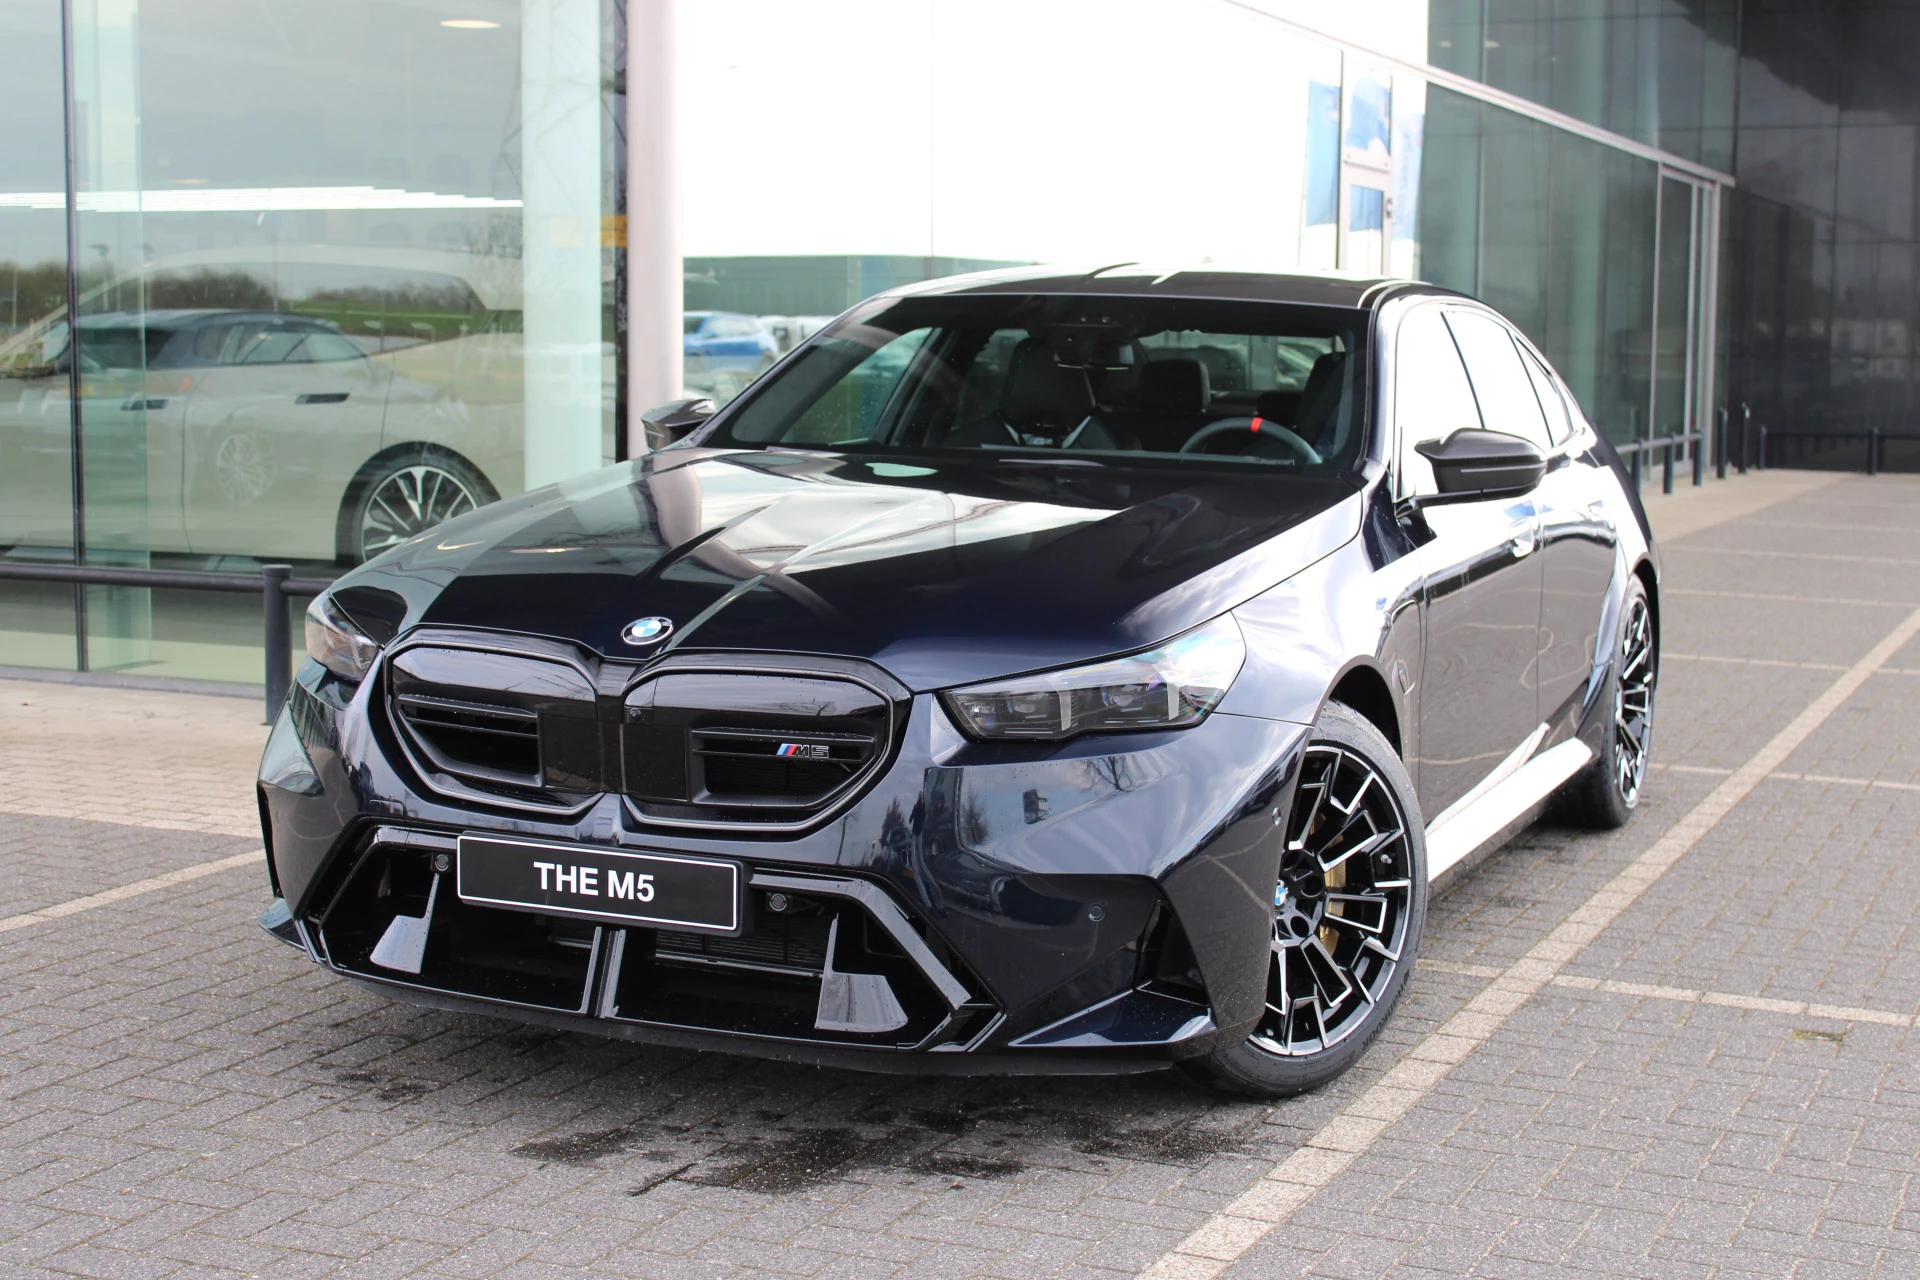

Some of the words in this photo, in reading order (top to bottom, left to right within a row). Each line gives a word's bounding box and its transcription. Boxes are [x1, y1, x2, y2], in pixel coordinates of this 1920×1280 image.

[793, 744, 829, 759] M5
[533, 861, 599, 896] THE
[607, 869, 655, 902] M5
